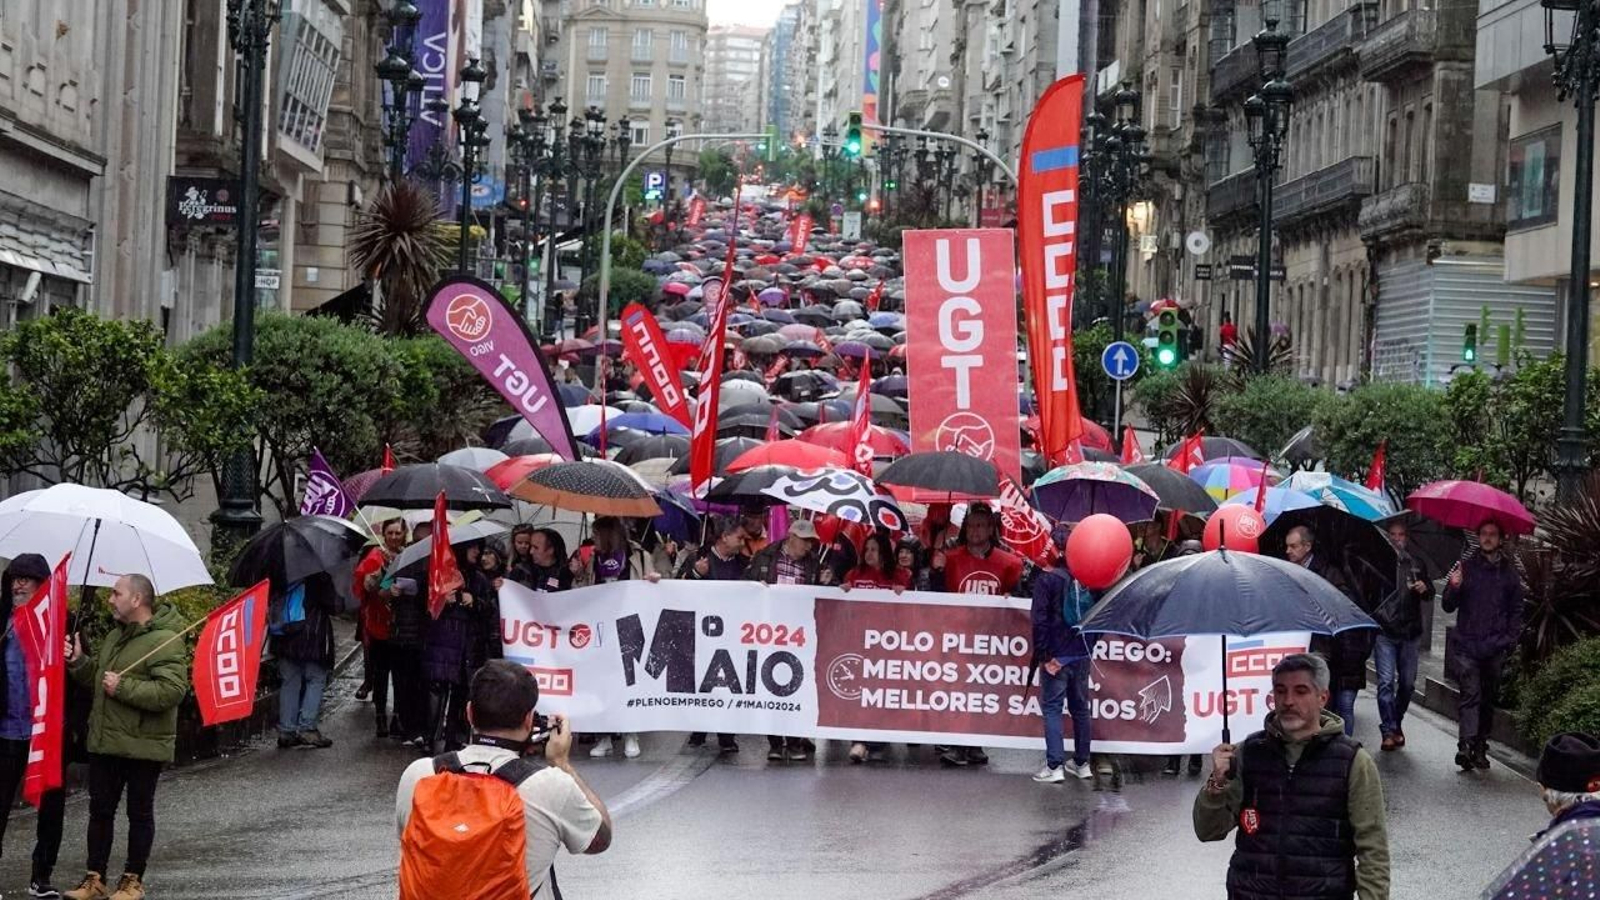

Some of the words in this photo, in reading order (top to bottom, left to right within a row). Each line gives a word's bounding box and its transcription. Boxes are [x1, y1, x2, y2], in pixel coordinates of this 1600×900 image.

[649, 174, 662, 190] P
[936, 238, 984, 409] UGT
[965, 580, 998, 595] UGT
[501, 618, 561, 649] UGT
[740, 623, 805, 647] 2024
[865, 630, 934, 651] POLO
[942, 633, 1028, 656] PLENO
[217, 609, 240, 698] CCOO
[863, 658, 958, 681] MENOS
[626, 697, 724, 708] #PLENOEMPREGO
[735, 699, 801, 712] #1MAIO2024
[861, 688, 999, 714] MELLORES
[1193, 688, 1258, 717] UGT
